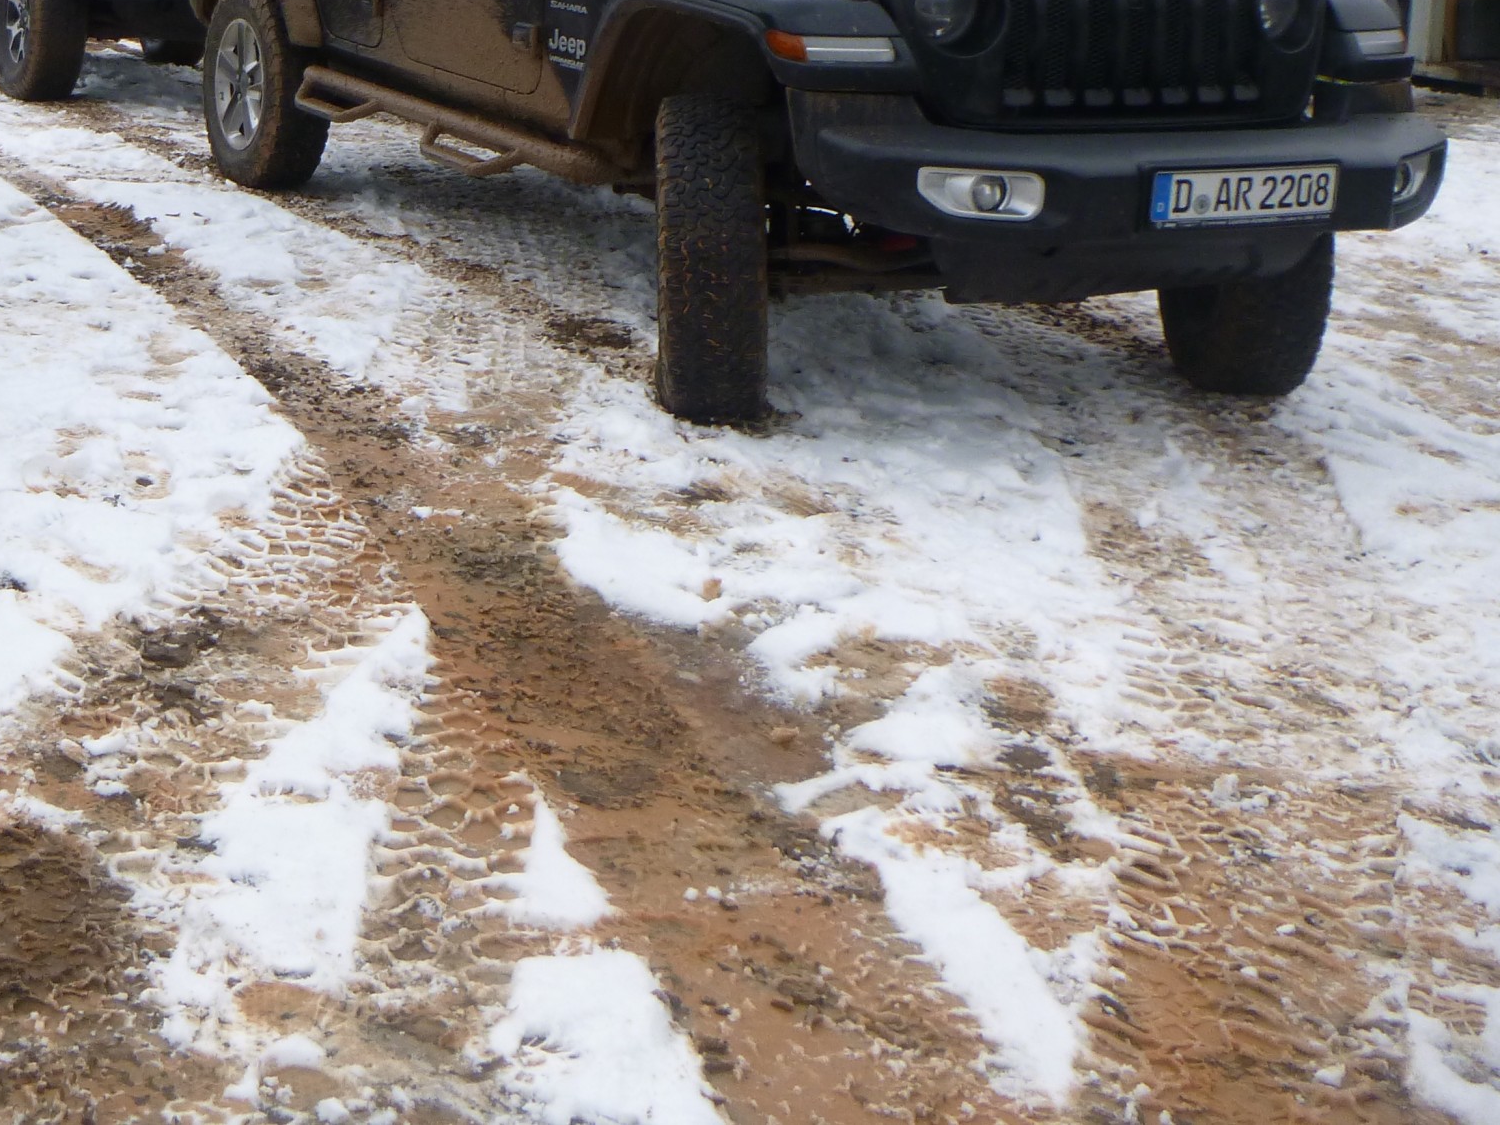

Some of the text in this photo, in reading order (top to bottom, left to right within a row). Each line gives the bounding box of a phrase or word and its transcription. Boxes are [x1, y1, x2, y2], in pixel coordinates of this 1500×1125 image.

[550, 0, 588, 14] SAHARA
[549, 28, 587, 59] Jeep
[1172, 173, 1330, 213] D AR 2208
